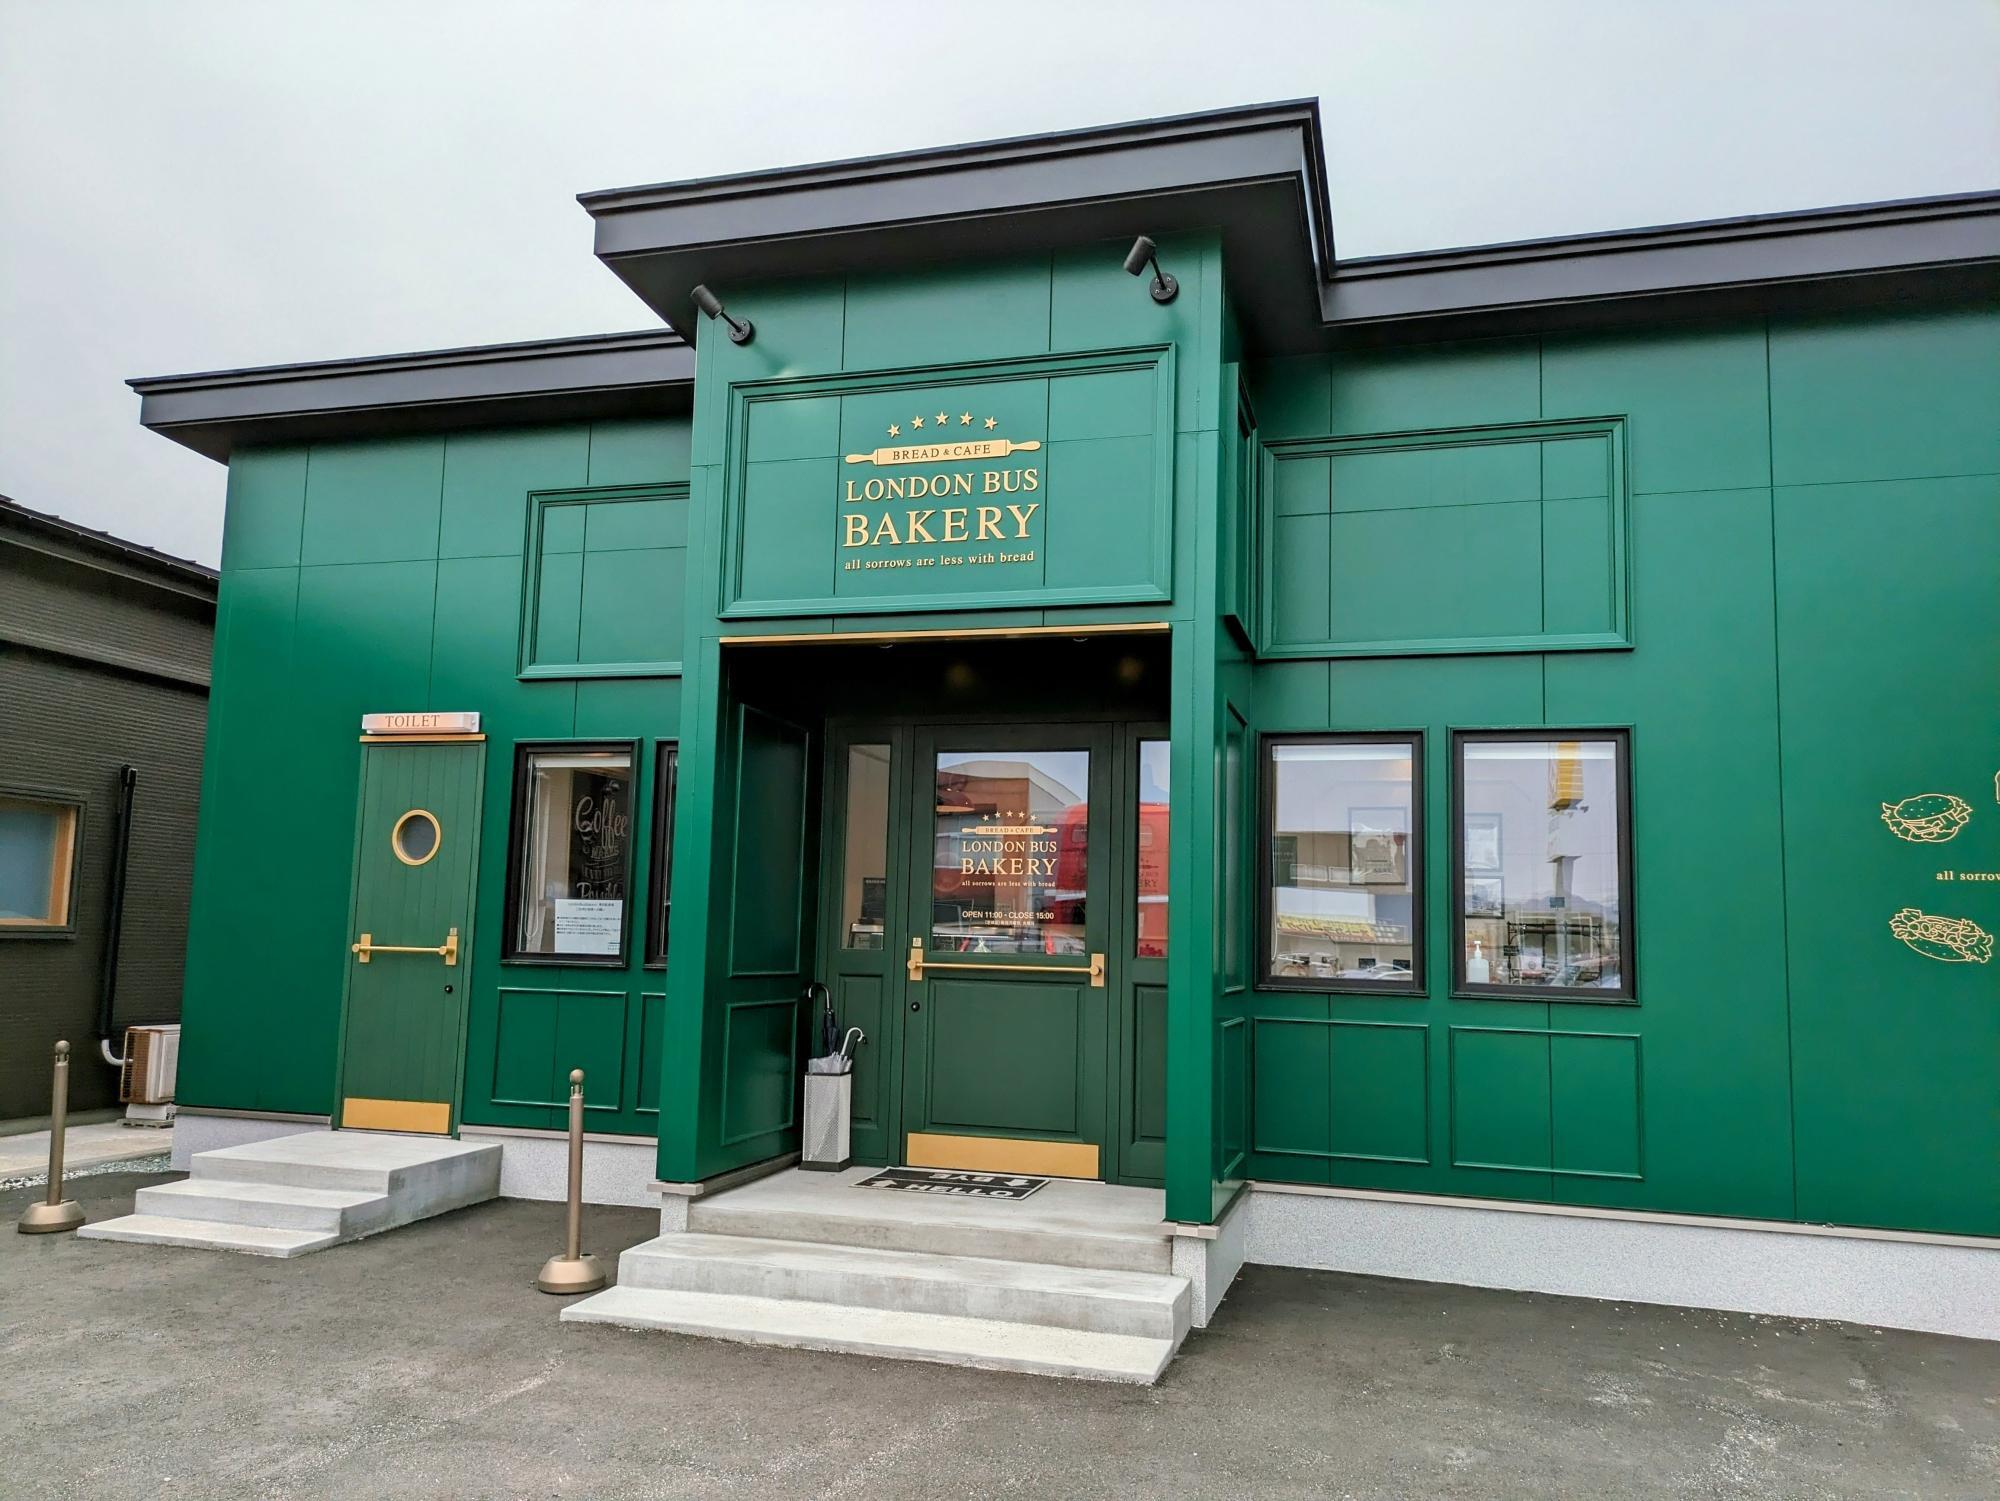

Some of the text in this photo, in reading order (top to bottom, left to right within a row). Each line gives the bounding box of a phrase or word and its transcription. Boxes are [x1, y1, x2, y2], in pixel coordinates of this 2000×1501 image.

[892, 444, 991, 461] BREAD & CAFE
[845, 468, 1039, 502] LONDON BUS
[842, 503, 1040, 547] BAKERY
[844, 551, 1035, 570] all sorrows are less with bread
[385, 714, 441, 727] TOILET
[575, 796, 628, 848] Coffee
[962, 841, 1057, 852] LONDON BUS
[960, 858, 1057, 875] BAKERY
[1936, 870, 1954, 881] all
[985, 911, 1003, 919] 11:00
[1008, 911, 1035, 919] CLOSE
[905, 1184, 1013, 1196] HELLO
